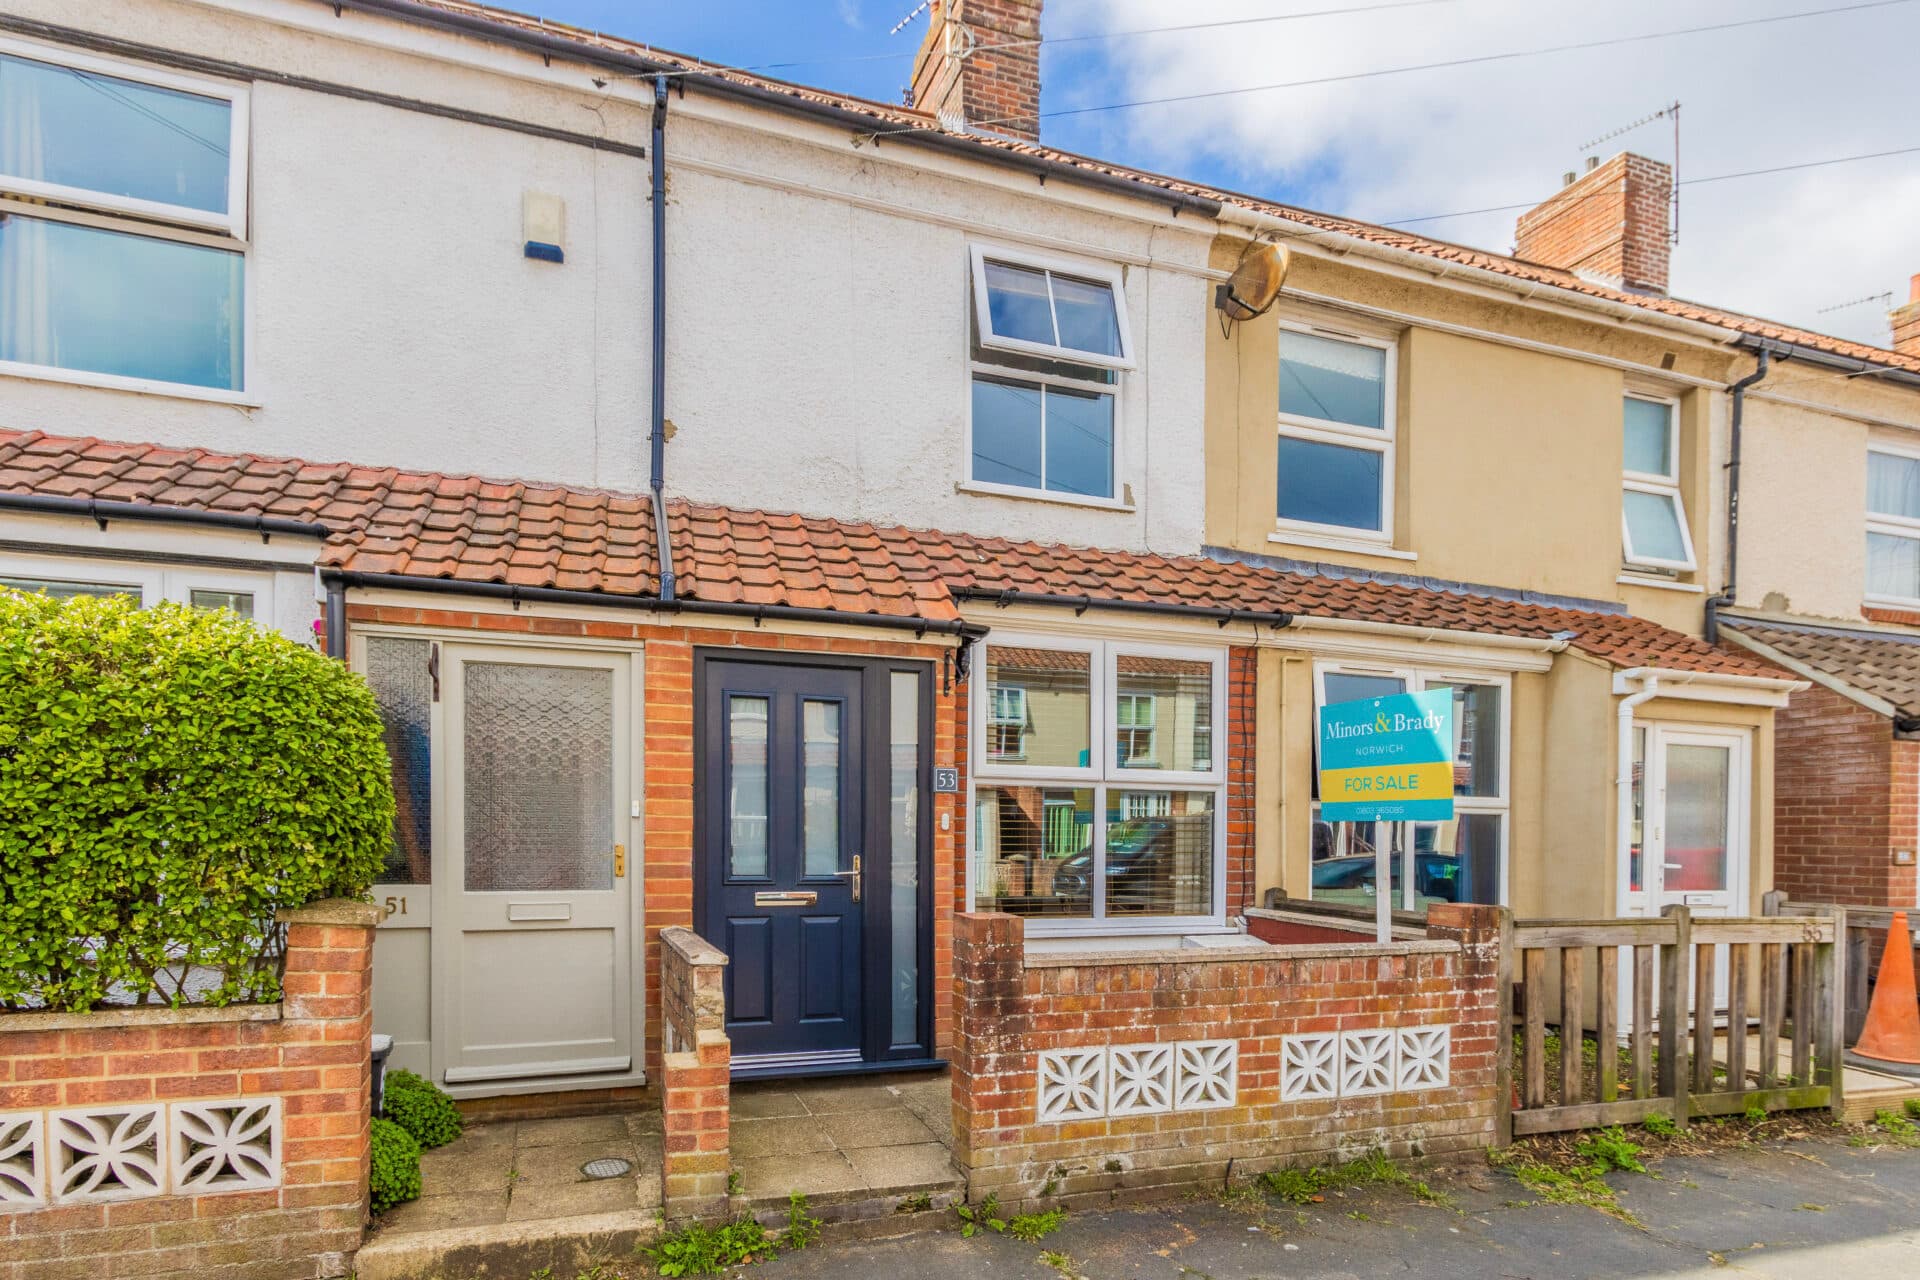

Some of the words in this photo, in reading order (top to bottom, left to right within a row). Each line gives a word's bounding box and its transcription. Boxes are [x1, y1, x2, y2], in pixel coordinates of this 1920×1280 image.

[1326, 720, 1374, 740] Minors
[1374, 711, 1391, 733] &
[1394, 710, 1444, 734] Brady
[1355, 744, 1404, 756] NORWICH
[938, 773, 955, 788] 53
[1344, 777, 1372, 792] FOR
[1375, 774, 1418, 791] SALE
[385, 896, 408, 915] 51
[1802, 923, 1822, 942] 55
